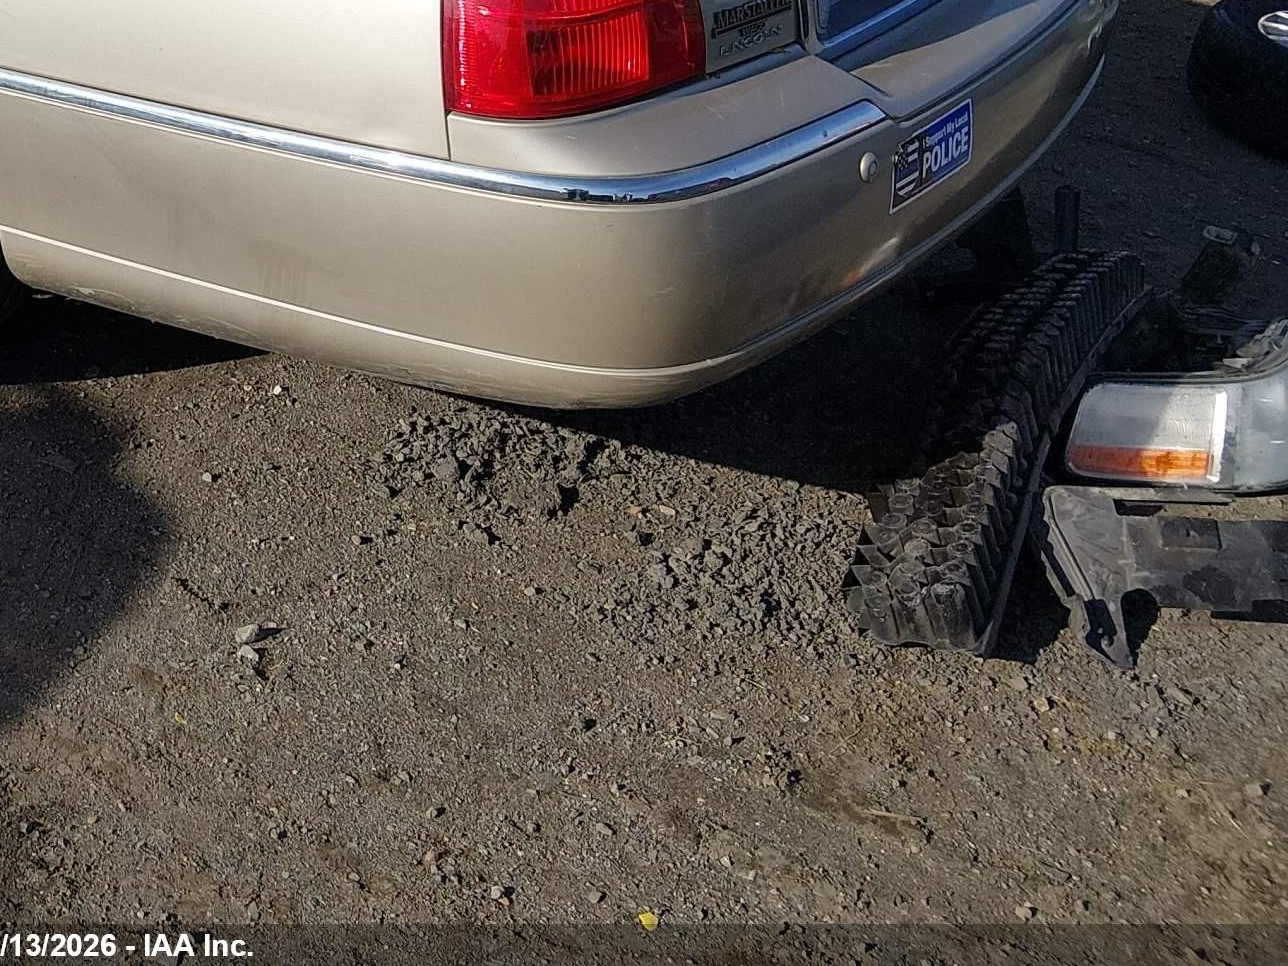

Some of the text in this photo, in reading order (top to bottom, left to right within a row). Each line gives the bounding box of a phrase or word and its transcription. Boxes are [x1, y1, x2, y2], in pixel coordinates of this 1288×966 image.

[925, 125, 947, 147] Support
[947, 121, 955, 134] My
[955, 111, 968, 128] Local
[922, 125, 969, 179] POLICE
